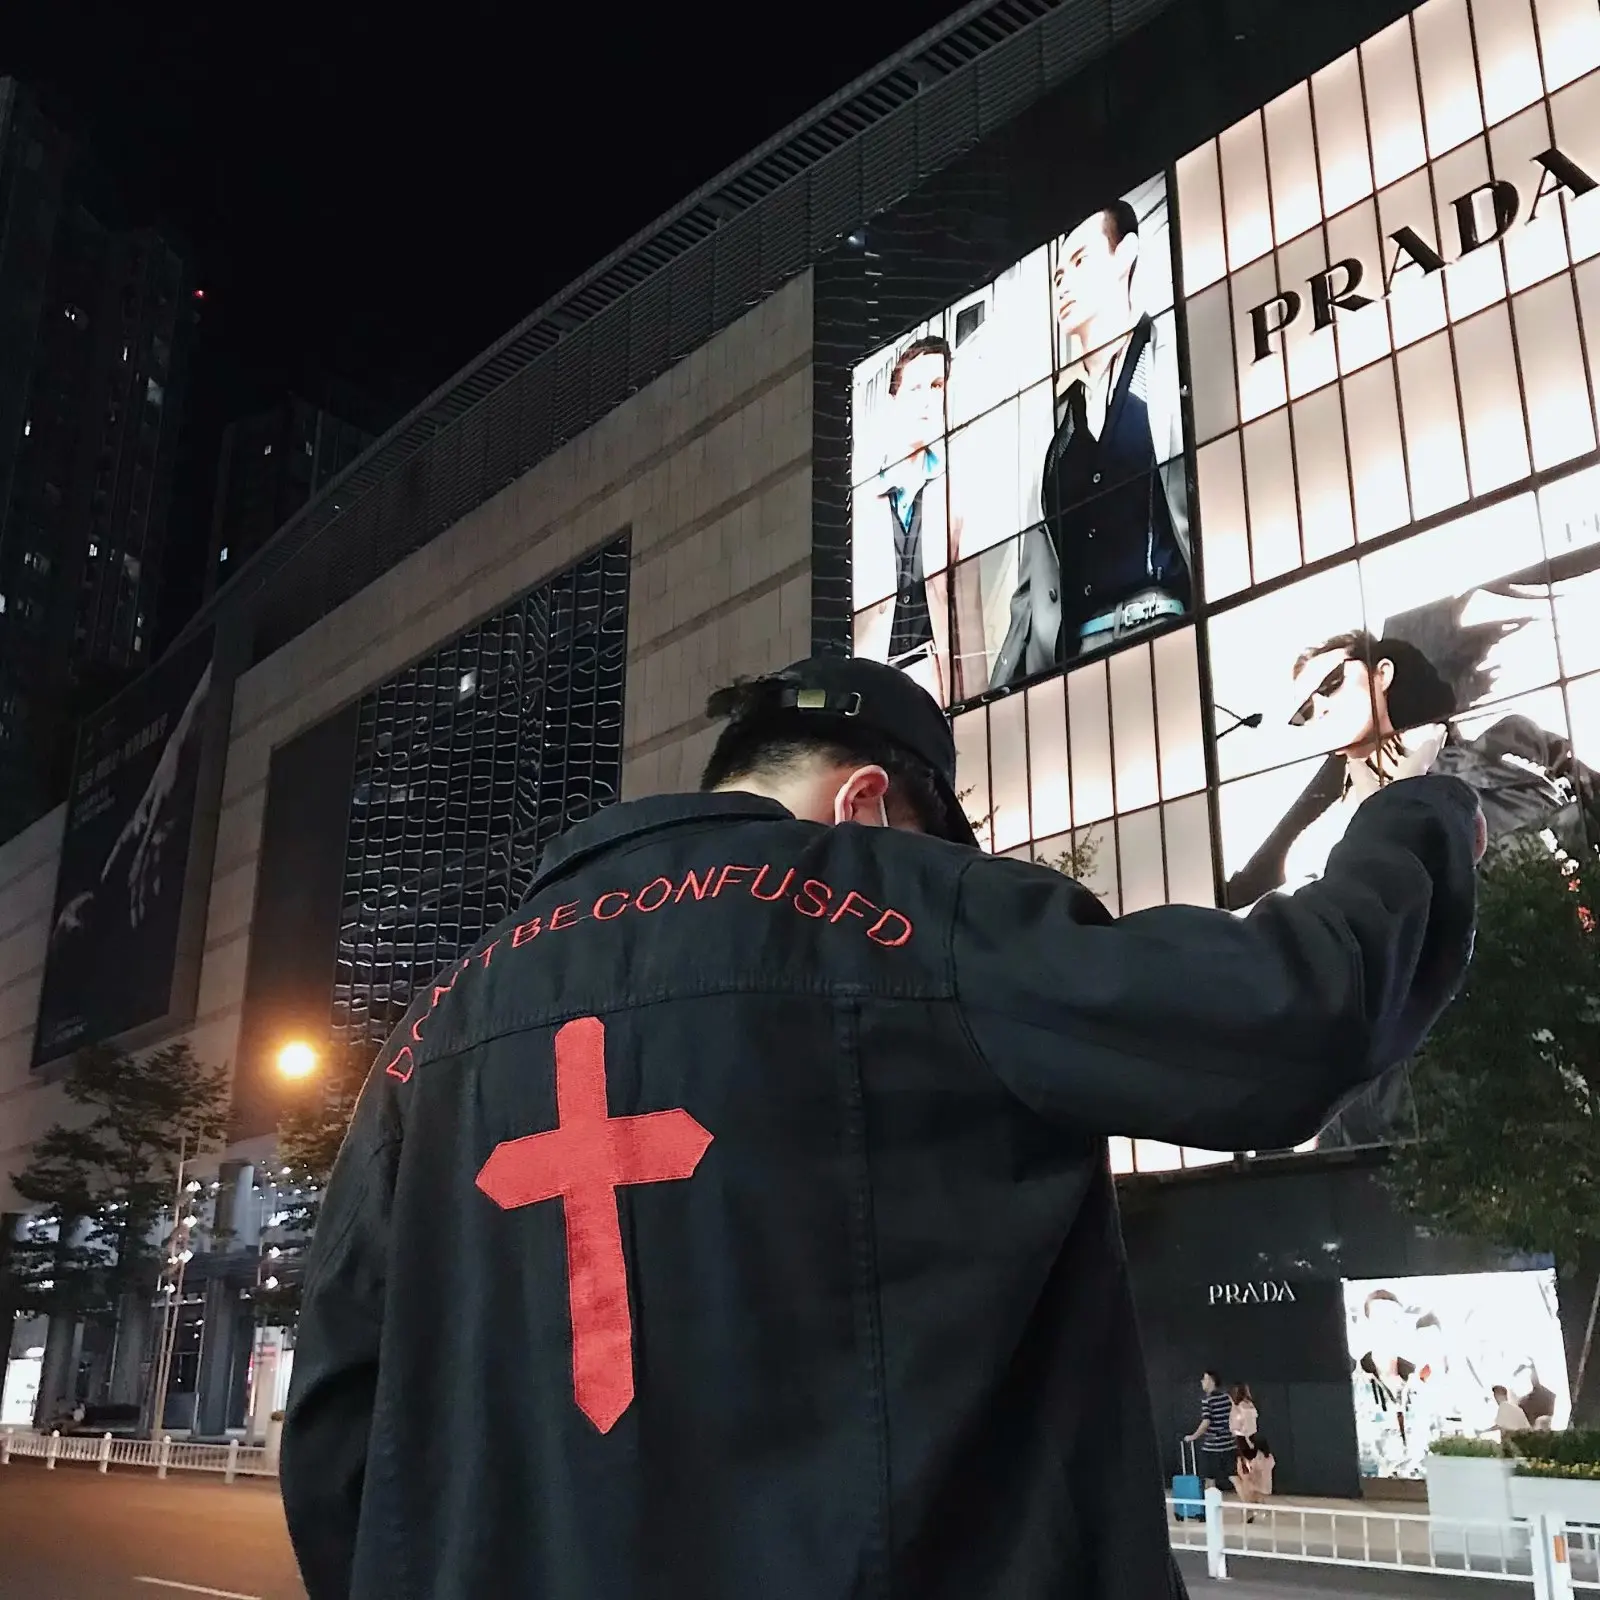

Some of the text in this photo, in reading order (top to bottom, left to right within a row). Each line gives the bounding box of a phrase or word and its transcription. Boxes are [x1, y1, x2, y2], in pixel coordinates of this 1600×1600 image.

[1247, 148, 1599, 364] PRADA
[511, 899, 580, 948] BE
[1208, 1280, 1297, 1305] PRADA
